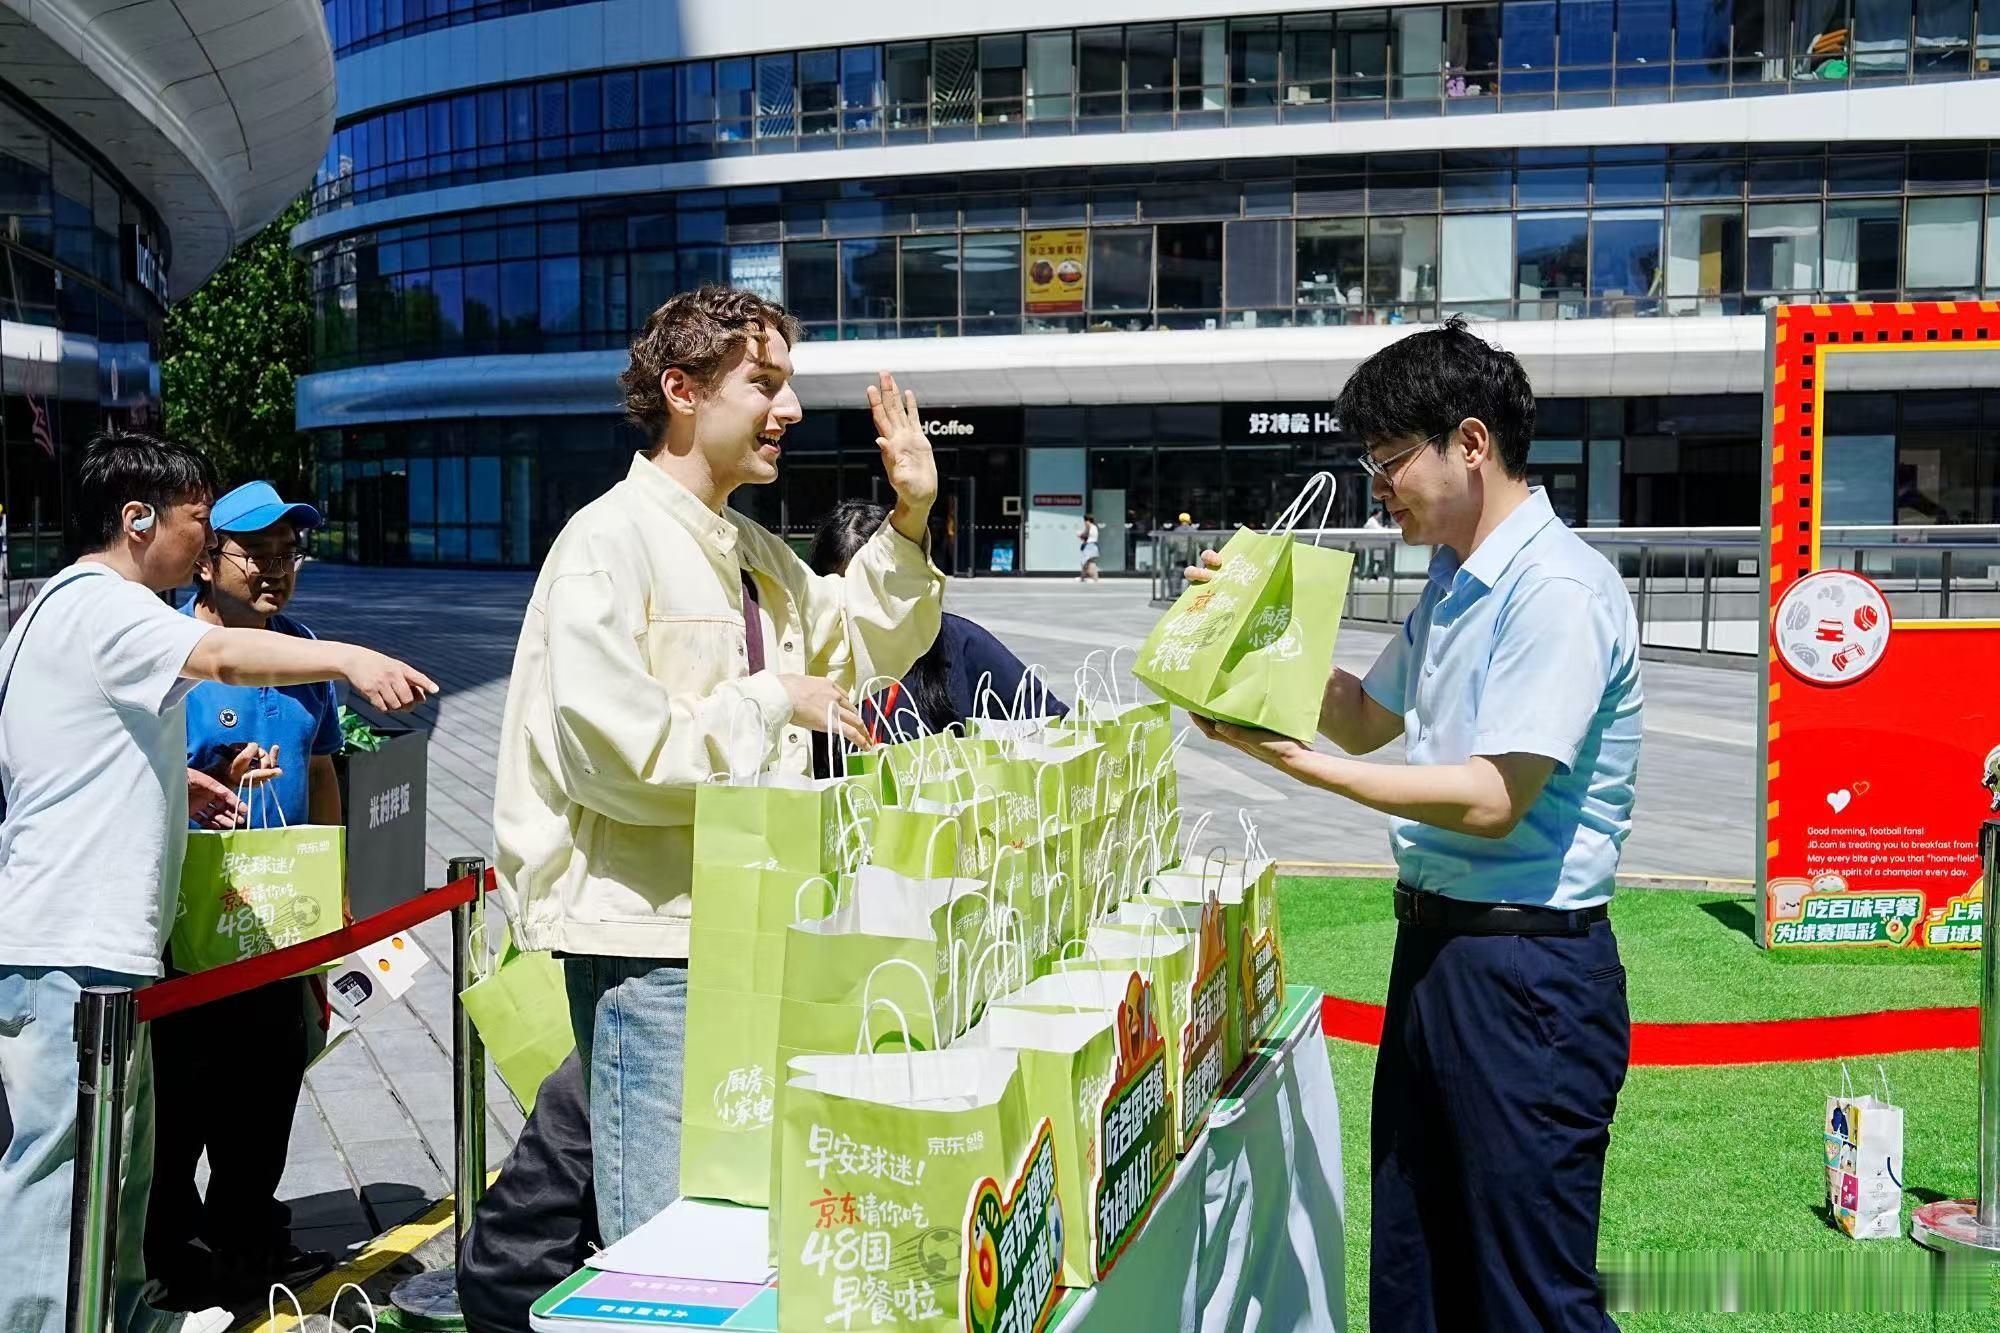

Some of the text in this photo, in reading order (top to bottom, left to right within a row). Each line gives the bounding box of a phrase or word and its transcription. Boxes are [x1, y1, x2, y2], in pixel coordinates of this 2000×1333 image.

[369, 783, 410, 829] 米村拌饭
[1808, 827, 1924, 837] Good morning, football fans!
[1808, 841, 1837, 849] JD.com
[1840, 841, 1846, 849] is
[1849, 841, 1880, 850] treating
[1883, 842, 1898, 850] you
[1901, 841, 1909, 849] to
[1911, 841, 1950, 849] breakfast
[1953, 841, 1972, 849] from
[219, 851, 296, 883] 早安球迷!
[1808, 855, 1824, 863] May
[1853, 855, 1867, 863] bite
[1870, 855, 1887, 864] give
[1890, 856, 1905, 864] you
[1908, 855, 1924, 863] that
[1842, 868, 1862, 877] spirit
[1864, 868, 1872, 876] of
[1883, 868, 1922, 877] champion
[1925, 869, 1948, 877] every
[1951, 868, 1968, 877] day.
[216, 903, 276, 938] 48国
[1806, 897, 1918, 918] 吃百味早餐
[1774, 922, 1877, 943] 为球赛喝彩
[724, 1064, 763, 1099] 厨房
[717, 1095, 774, 1128] 小家电
[1105, 1057, 1164, 1168] 吃各国早餐
[805, 1124, 926, 1186] 早安球迷!
[810, 1188, 929, 1229] 京东请你吃
[1000, 1138, 1055, 1290] 京东搜索
[800, 1227, 891, 1277] 48国
[824, 1275, 944, 1331] 早餐啦
